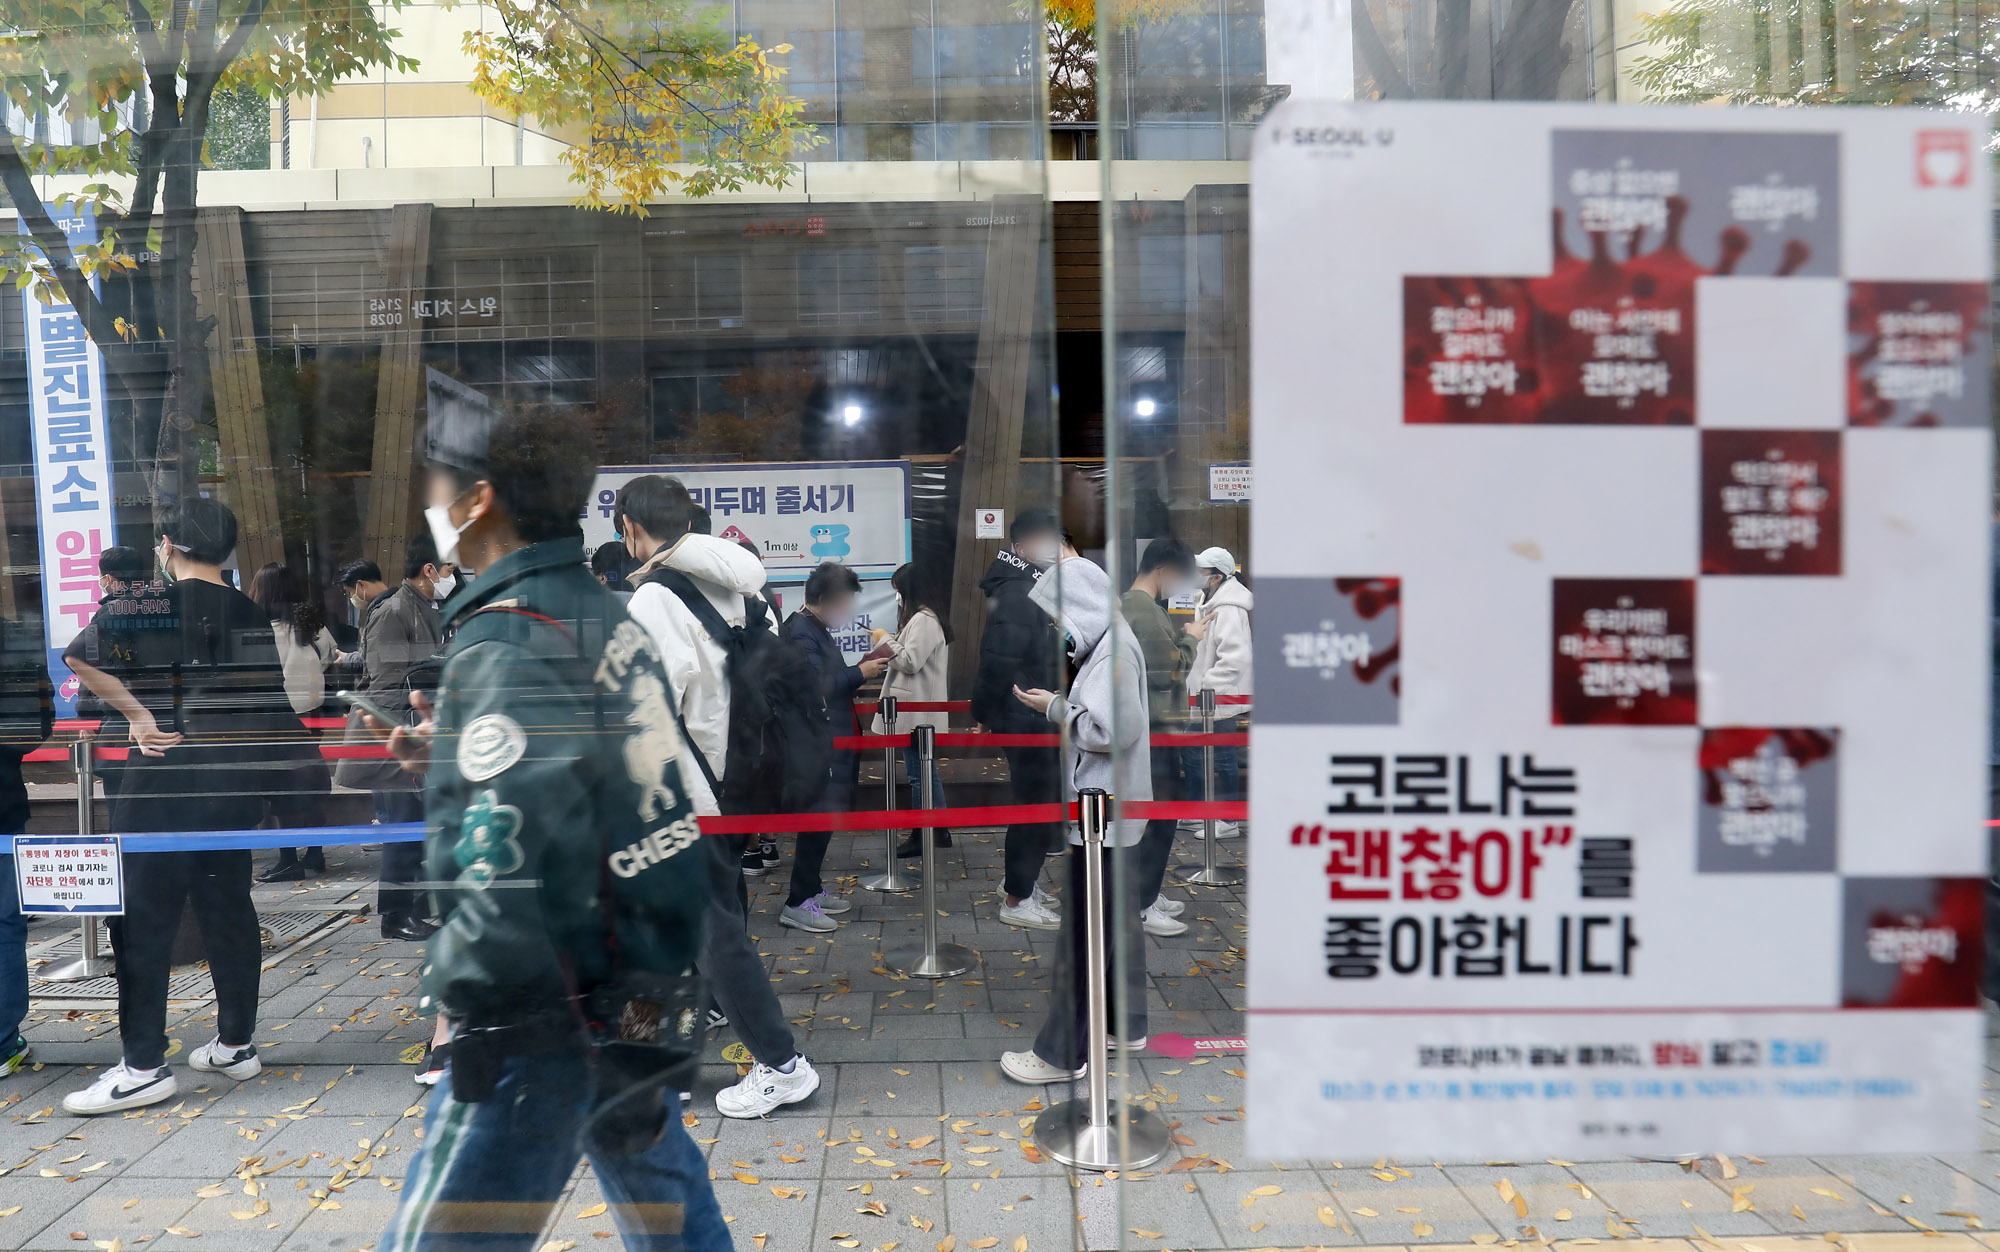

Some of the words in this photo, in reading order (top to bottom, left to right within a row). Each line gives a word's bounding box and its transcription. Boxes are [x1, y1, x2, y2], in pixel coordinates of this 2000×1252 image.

[57, 217, 87, 234] 파구
[1429, 360, 1518, 396] 괜찮아
[1581, 361, 1670, 397] 괜찮아
[687, 486, 766, 517] 리두며
[775, 484, 855, 515] 줄서기
[764, 540, 781, 552] 1m
[783, 542, 799, 552] 이상
[1729, 514, 1820, 550] 괜찮아
[55, 528, 101, 630] 입구
[1284, 631, 1371, 669] 괜찮아
[1580, 661, 1671, 697] 괜찮아
[1327, 755, 1577, 817] 코로나는
[54, 848, 79, 858] 지장이
[83, 848, 108, 858] 없도록
[608, 812, 701, 878] CHESS
[32, 864, 54, 873] 코로나
[58, 863, 73, 872] 검사
[77, 863, 108, 872] 대기자는
[58, 876, 94, 887] 안쪽에서
[97, 877, 113, 886] 대기
[1324, 912, 1639, 978] 좋아합니다
[1194, 1040, 1248, 1050] 선별진
